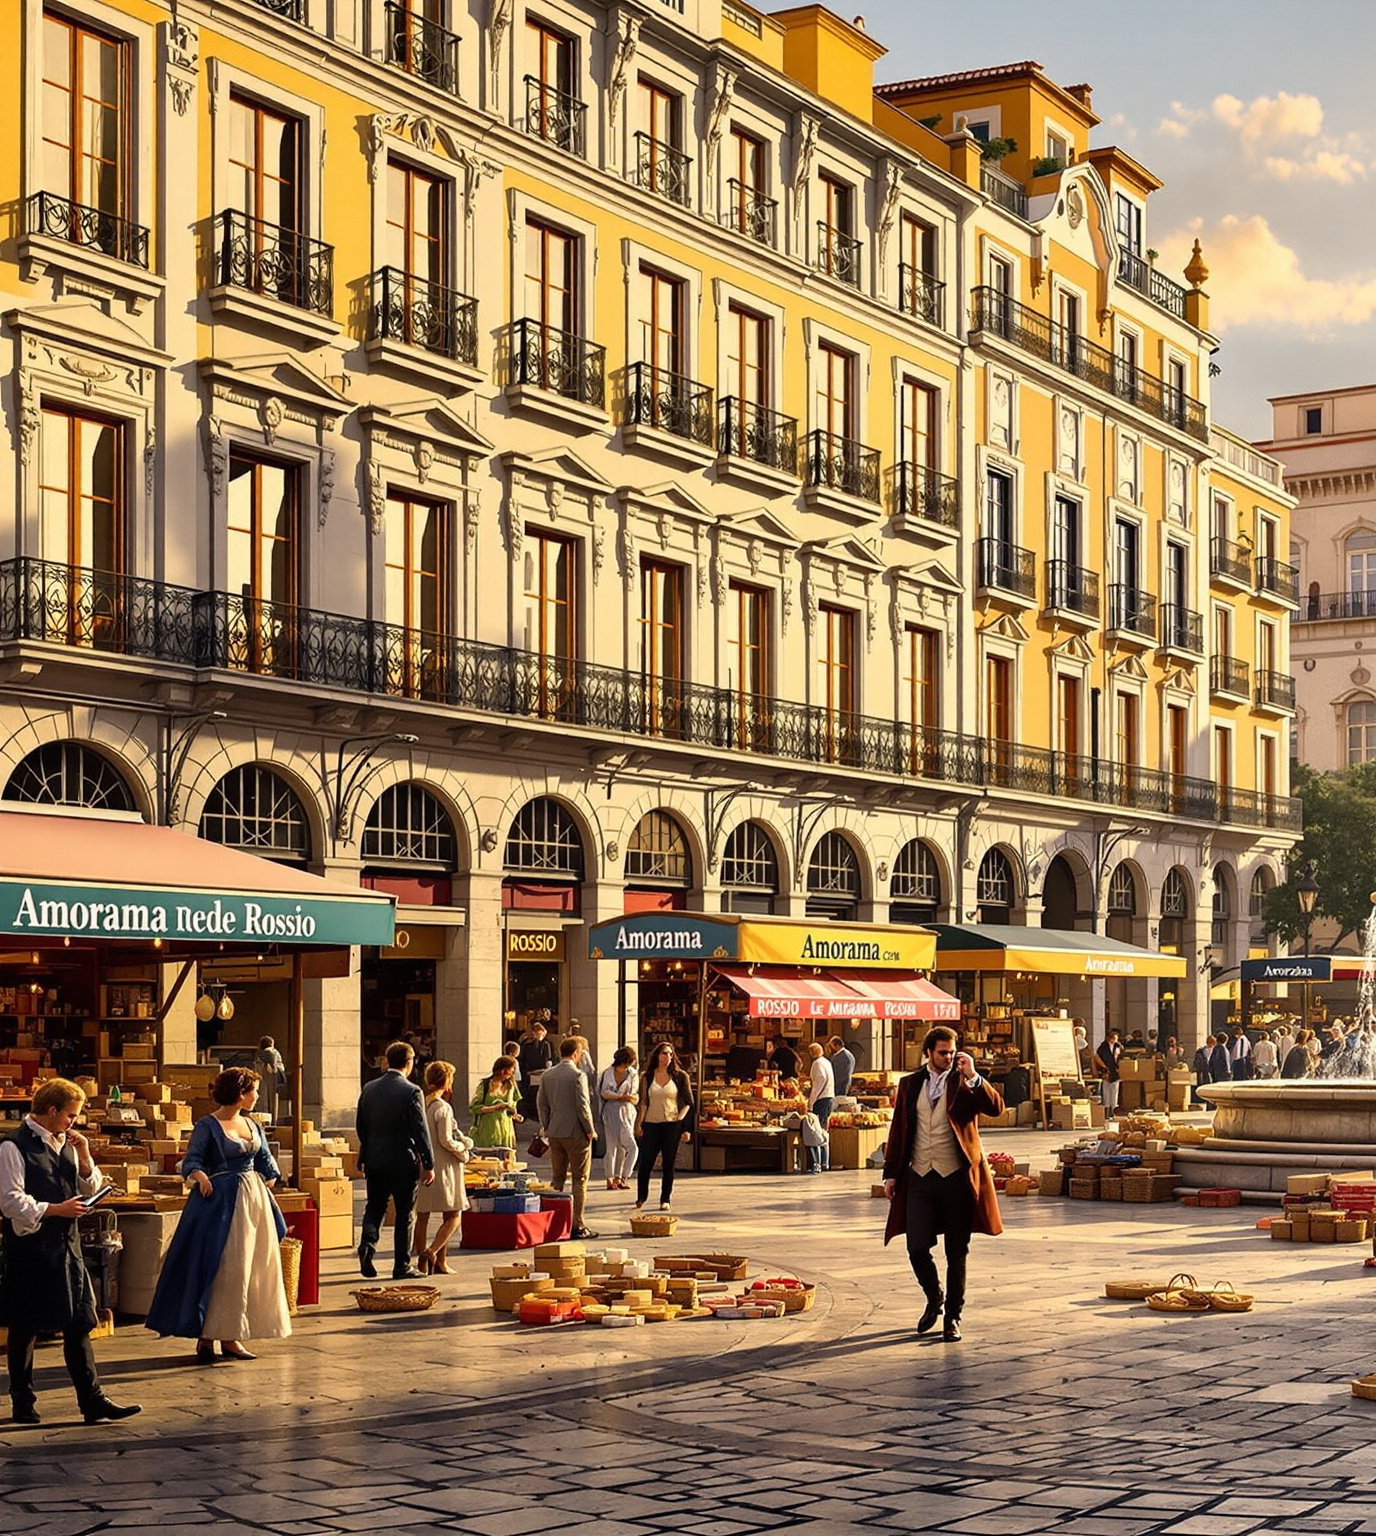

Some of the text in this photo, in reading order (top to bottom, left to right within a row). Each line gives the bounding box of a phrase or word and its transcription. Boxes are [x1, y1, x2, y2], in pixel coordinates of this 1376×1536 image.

[13, 888, 168, 932] Amorama
[243, 903, 316, 938] Rossio
[510, 933, 557, 952] ROSSIO
[615, 926, 703, 950] Amorama
[801, 934, 880, 961] Amorama
